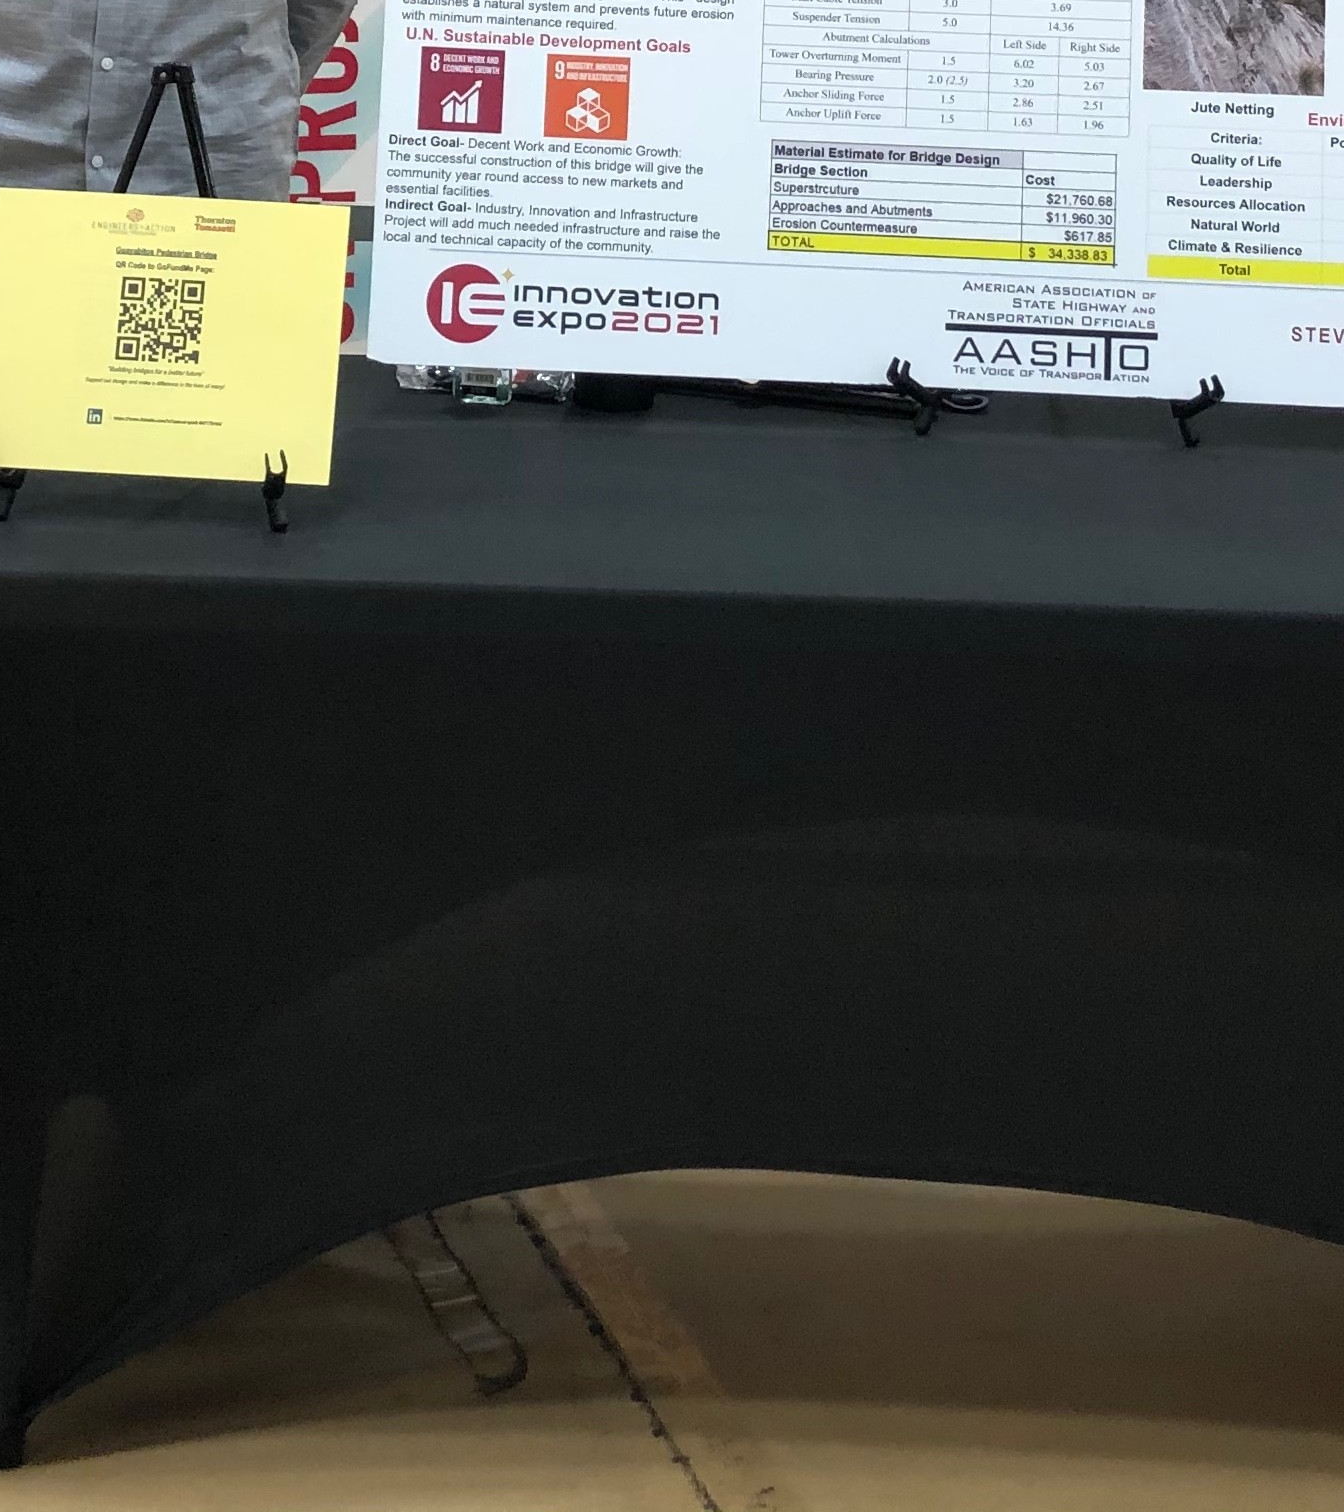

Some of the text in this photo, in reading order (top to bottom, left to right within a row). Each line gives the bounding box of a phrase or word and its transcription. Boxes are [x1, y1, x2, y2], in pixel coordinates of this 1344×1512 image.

[406, 27, 690, 53] U.N. Sustainable Development Goals
[1191, 101, 1274, 118] Jute Netting
[389, 134, 426, 146] Direct
[468, 138, 510, 150] Decent
[514, 140, 544, 152] Work
[548, 142, 570, 153] and
[574, 142, 632, 156] Economic
[1211, 132, 1262, 145] Criteria:
[774, 144, 1000, 166] Material Estimate for Bridge Design
[1191, 153, 1282, 168] Quality of Life
[774, 164, 868, 178] Bridge Section
[1025, 174, 1055, 186] Cost
[1200, 175, 1272, 192] Leadership
[772, 200, 933, 217] Approaches and Abutments
[1166, 196, 1305, 212] Resources Allocation
[772, 218, 918, 234] Erosion Countermeasure
[1191, 218, 1280, 233] Natural World
[772, 236, 817, 248] TOTAL
[1168, 239, 1302, 256] Climate & Resilience
[1028, 247, 1038, 258] $
[1219, 264, 1252, 276] Total
[514, 285, 719, 310] innovation
[513, 310, 718, 335] expo2021
[953, 334, 1150, 378] AASHTO
